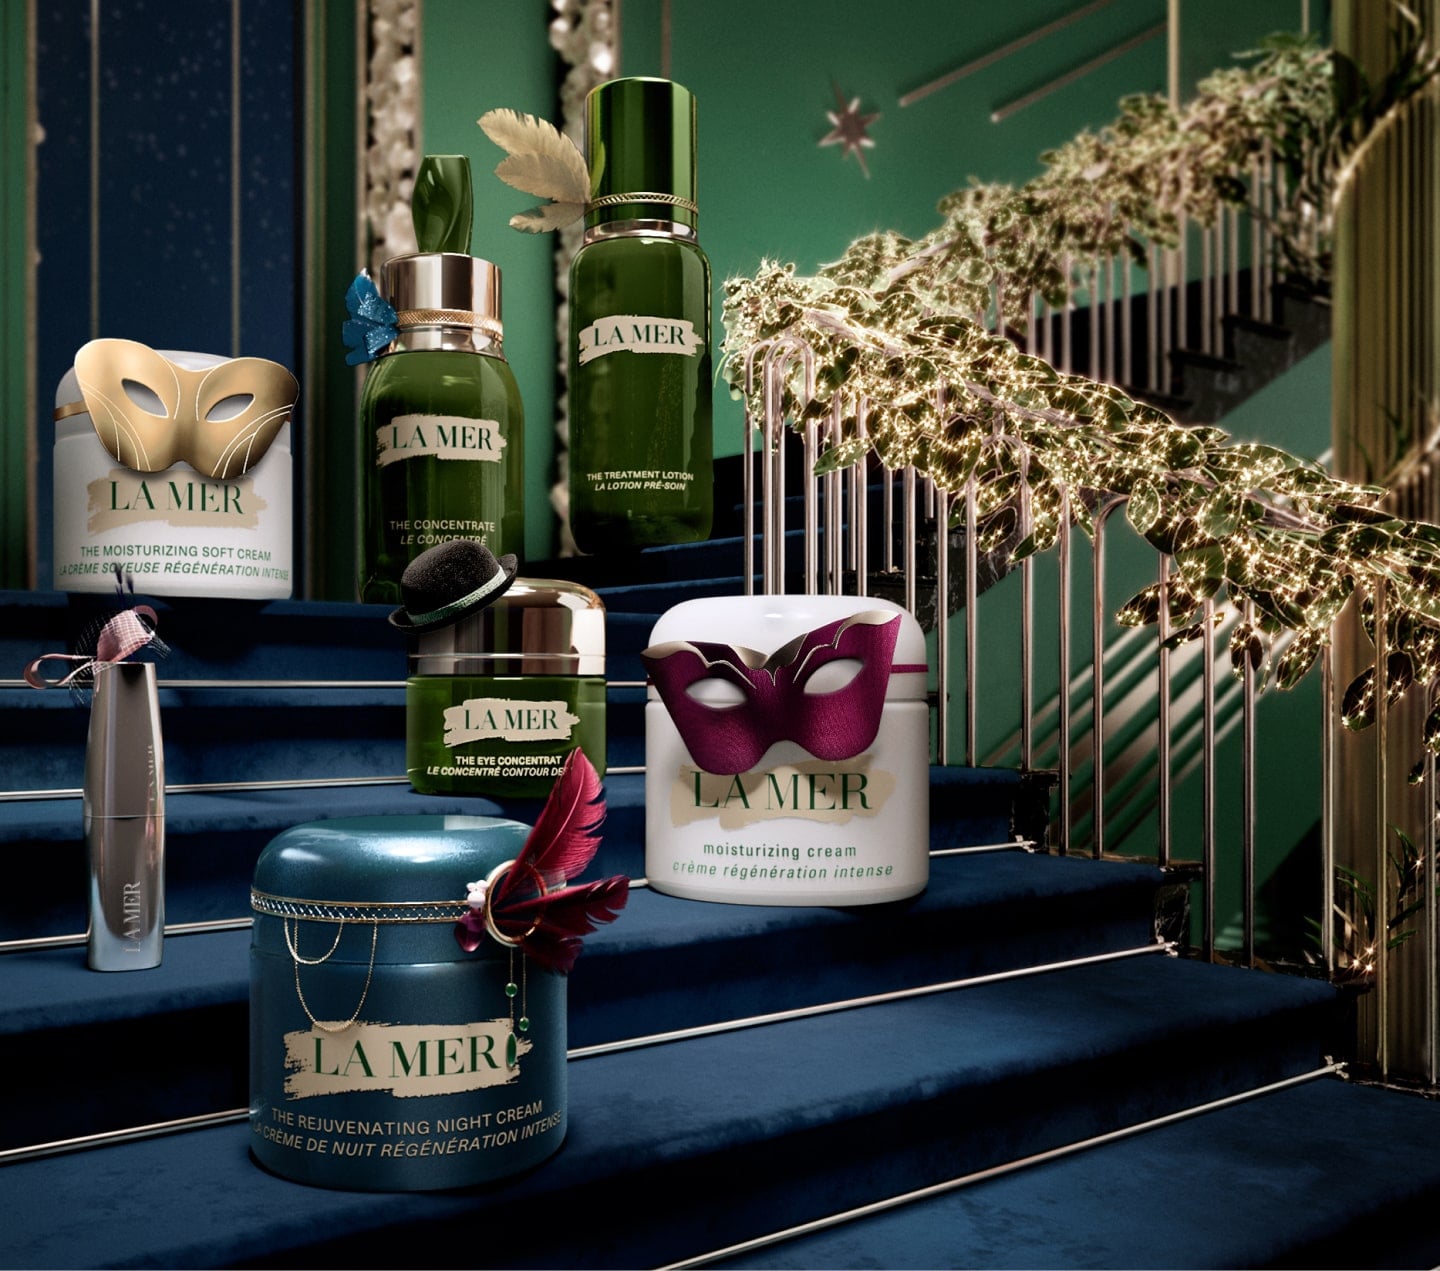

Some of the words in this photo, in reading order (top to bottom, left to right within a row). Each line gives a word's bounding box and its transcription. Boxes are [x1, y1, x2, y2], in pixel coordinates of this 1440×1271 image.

[594, 326, 624, 346] LA
[632, 325, 685, 346] MER
[392, 425, 427, 449] LA
[436, 425, 493, 450] MER
[587, 473, 602, 481] THE
[604, 471, 660, 479] TREATMENT
[662, 471, 694, 481] LOTION
[595, 483, 605, 491] LA
[607, 482, 642, 490] LOTION
[109, 481, 155, 510] LA
[167, 481, 244, 515] MER
[389, 520, 411, 530] THE
[414, 520, 495, 532] CONCENTRATE
[400, 535, 414, 545] LE
[80, 546, 100, 557] THE
[103, 545, 198, 557] MOISTURIZING
[202, 546, 234, 558] SOFT
[237, 549, 271, 561] CREAM
[102, 562, 160, 574] SOYEUSE
[164, 561, 260, 577] RÉGÉNÉRATION
[464, 709, 497, 730] LA
[505, 709, 559, 730] MER
[455, 756, 474, 765] THE
[477, 756, 495, 765] EYE
[427, 766, 439, 775] LE
[440, 766, 500, 777] CONCENTRÉ
[502, 767, 549, 776] CONTOUR
[550, 767, 566, 776] DE
[690, 771, 750, 809] LA
[764, 772, 872, 810] MER
[703, 843, 800, 860] moisturizing
[807, 845, 857, 858] cream
[672, 860, 717, 876] crème
[723, 862, 827, 880] régénération
[833, 864, 893, 879] intense
[123, 881, 141, 924] MER
[123, 928, 141, 953] LA
[312, 1037, 377, 1078] LA
[388, 1034, 502, 1079] MER
[271, 1107, 294, 1127] THE
[298, 1114, 430, 1136] REJUVENATING
[436, 1113, 492, 1133] NIGHT
[496, 1099, 543, 1125] CREAM
[263, 1125, 303, 1150] CRÈME
[306, 1137, 328, 1153] DE
[332, 1141, 377, 1157] NUIT
[380, 1128, 518, 1158] RÉGÉNÉRATION
